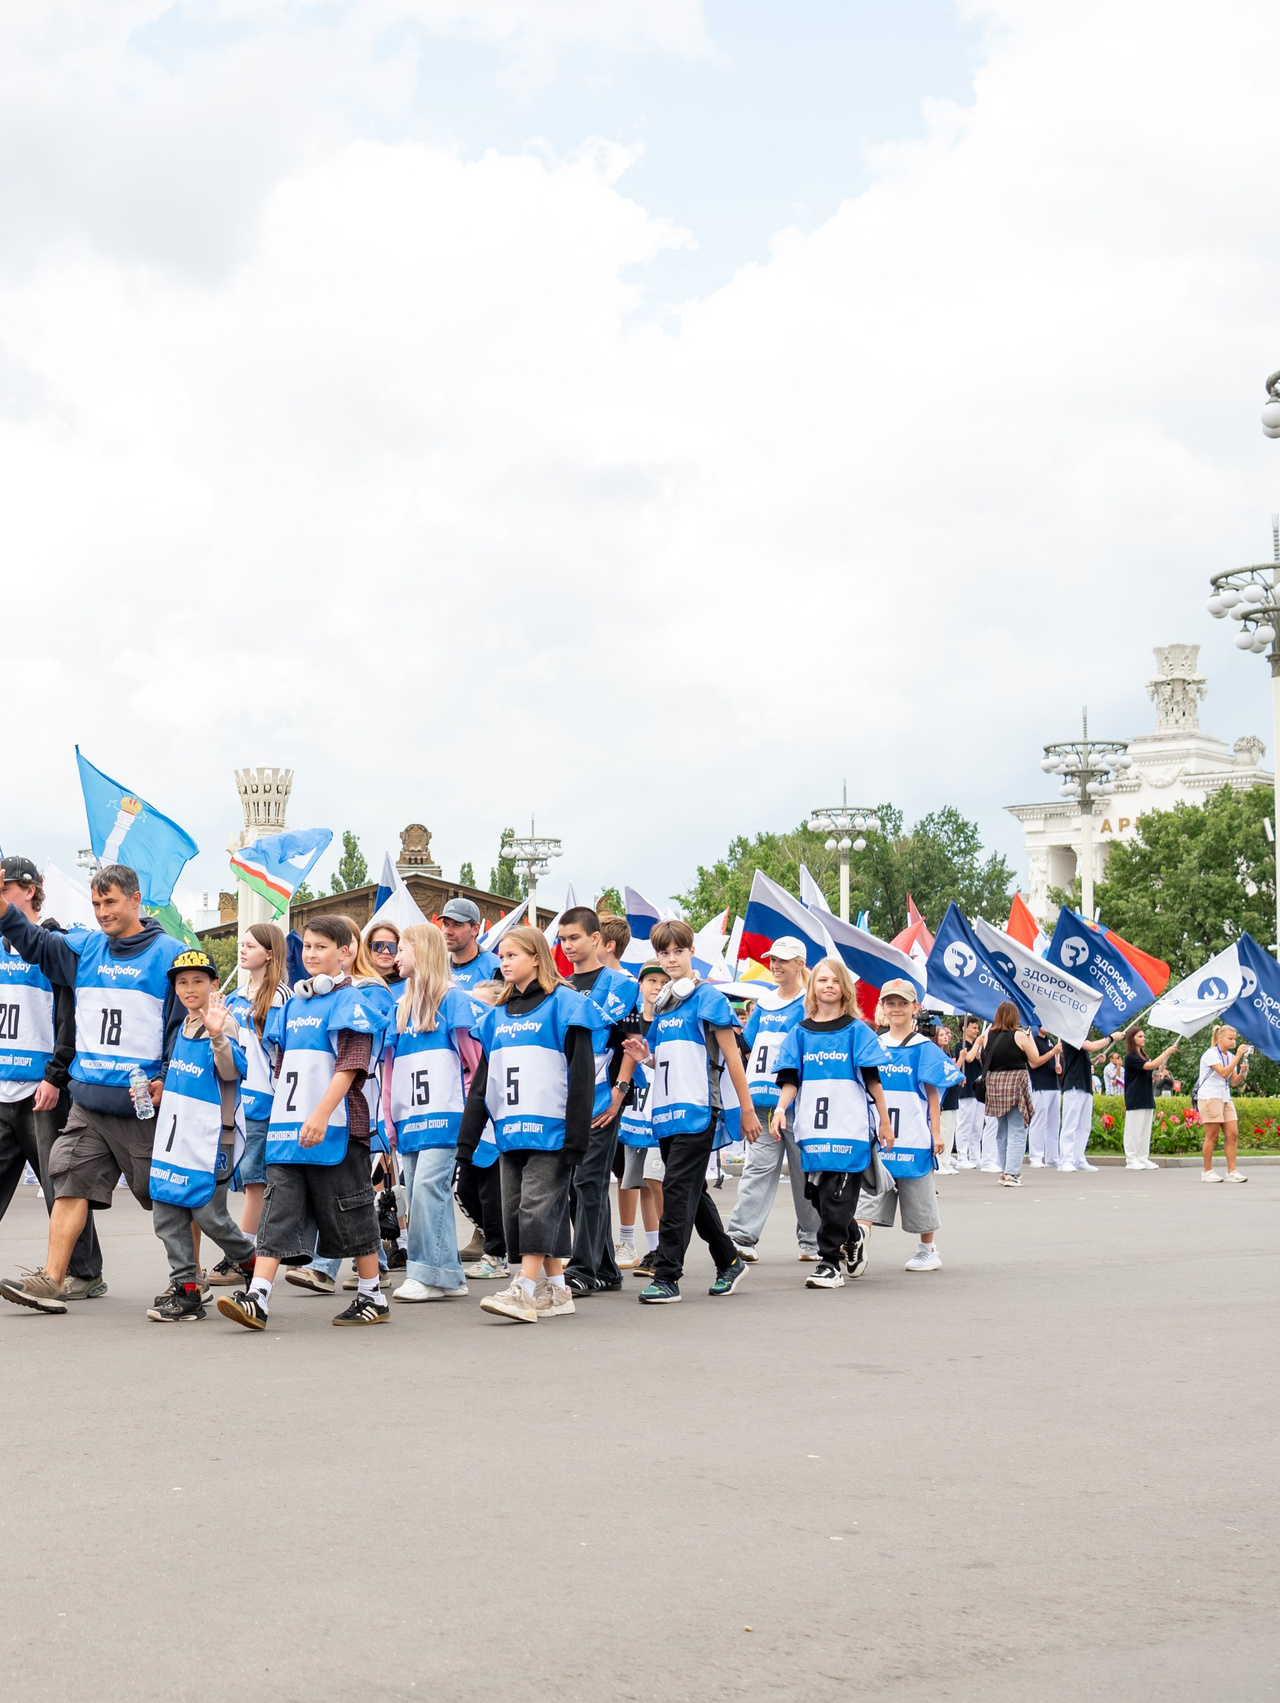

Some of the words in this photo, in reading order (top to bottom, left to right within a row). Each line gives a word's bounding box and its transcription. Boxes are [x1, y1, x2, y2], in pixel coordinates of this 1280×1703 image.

[173, 958, 210, 967] WARS
[177, 951, 208, 961] STAR
[1088, 965, 1127, 1012] ОТЕЧЕСТВО
[1093, 953, 1138, 1002] ЗДОРОВОЕ
[1020, 979, 1089, 1014] ОТЕЧЕСТВО
[99, 1008, 122, 1046] 18
[495, 1020, 543, 1038] playToday
[755, 1045, 769, 1074] 9
[286, 1071, 299, 1112] 2
[410, 1069, 430, 1107] 15
[506, 1066, 520, 1106] 5
[659, 1060, 670, 1097] 7
[428, 1118, 449, 1130] СПОРТ
[522, 1122, 544, 1134] СПОРТ
[813, 1096, 829, 1130] 8
[165, 1114, 177, 1153] 1
[832, 1144, 853, 1155] СПОРТ
